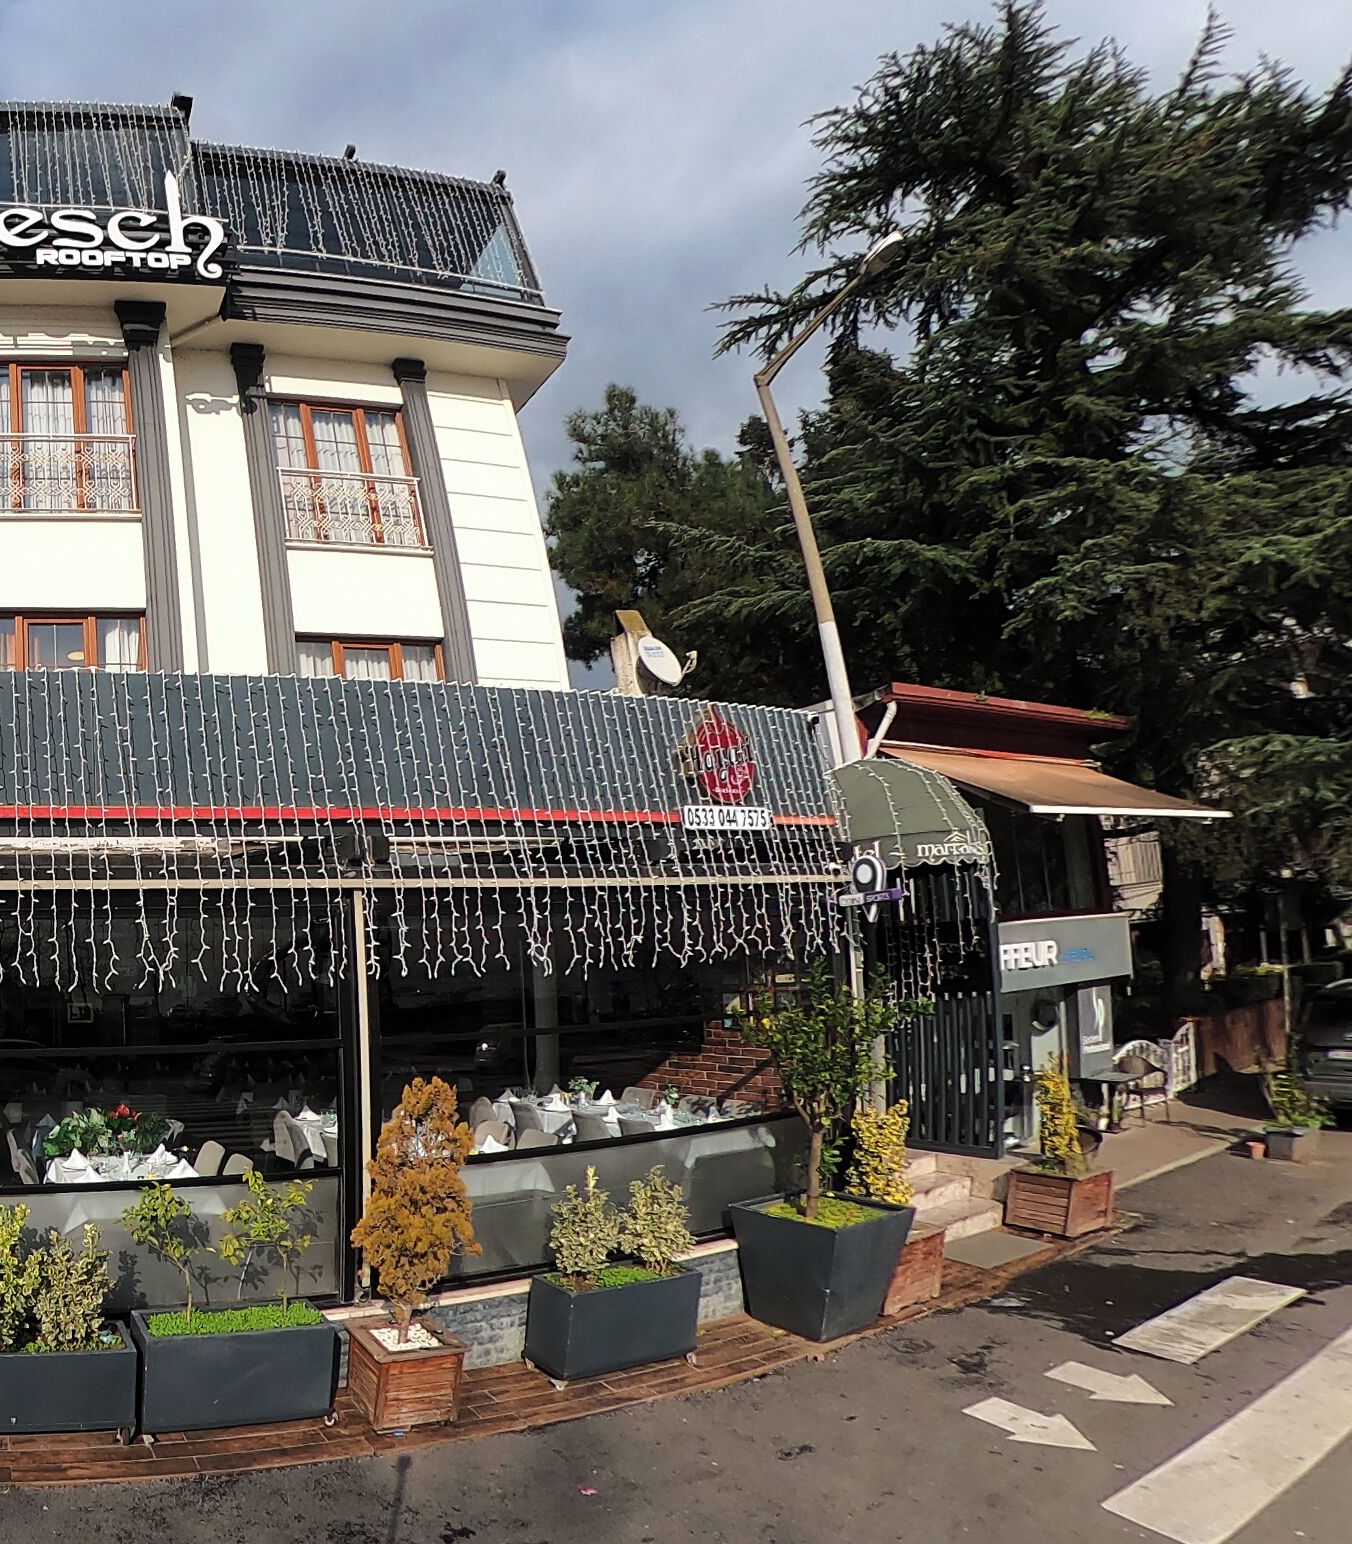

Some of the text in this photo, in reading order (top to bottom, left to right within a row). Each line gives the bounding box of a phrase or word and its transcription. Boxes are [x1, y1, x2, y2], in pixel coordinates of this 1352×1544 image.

[36, 248, 192, 270] ROOFTOP
[687, 807, 715, 828] 0533
[740, 809, 768, 828] 7575
